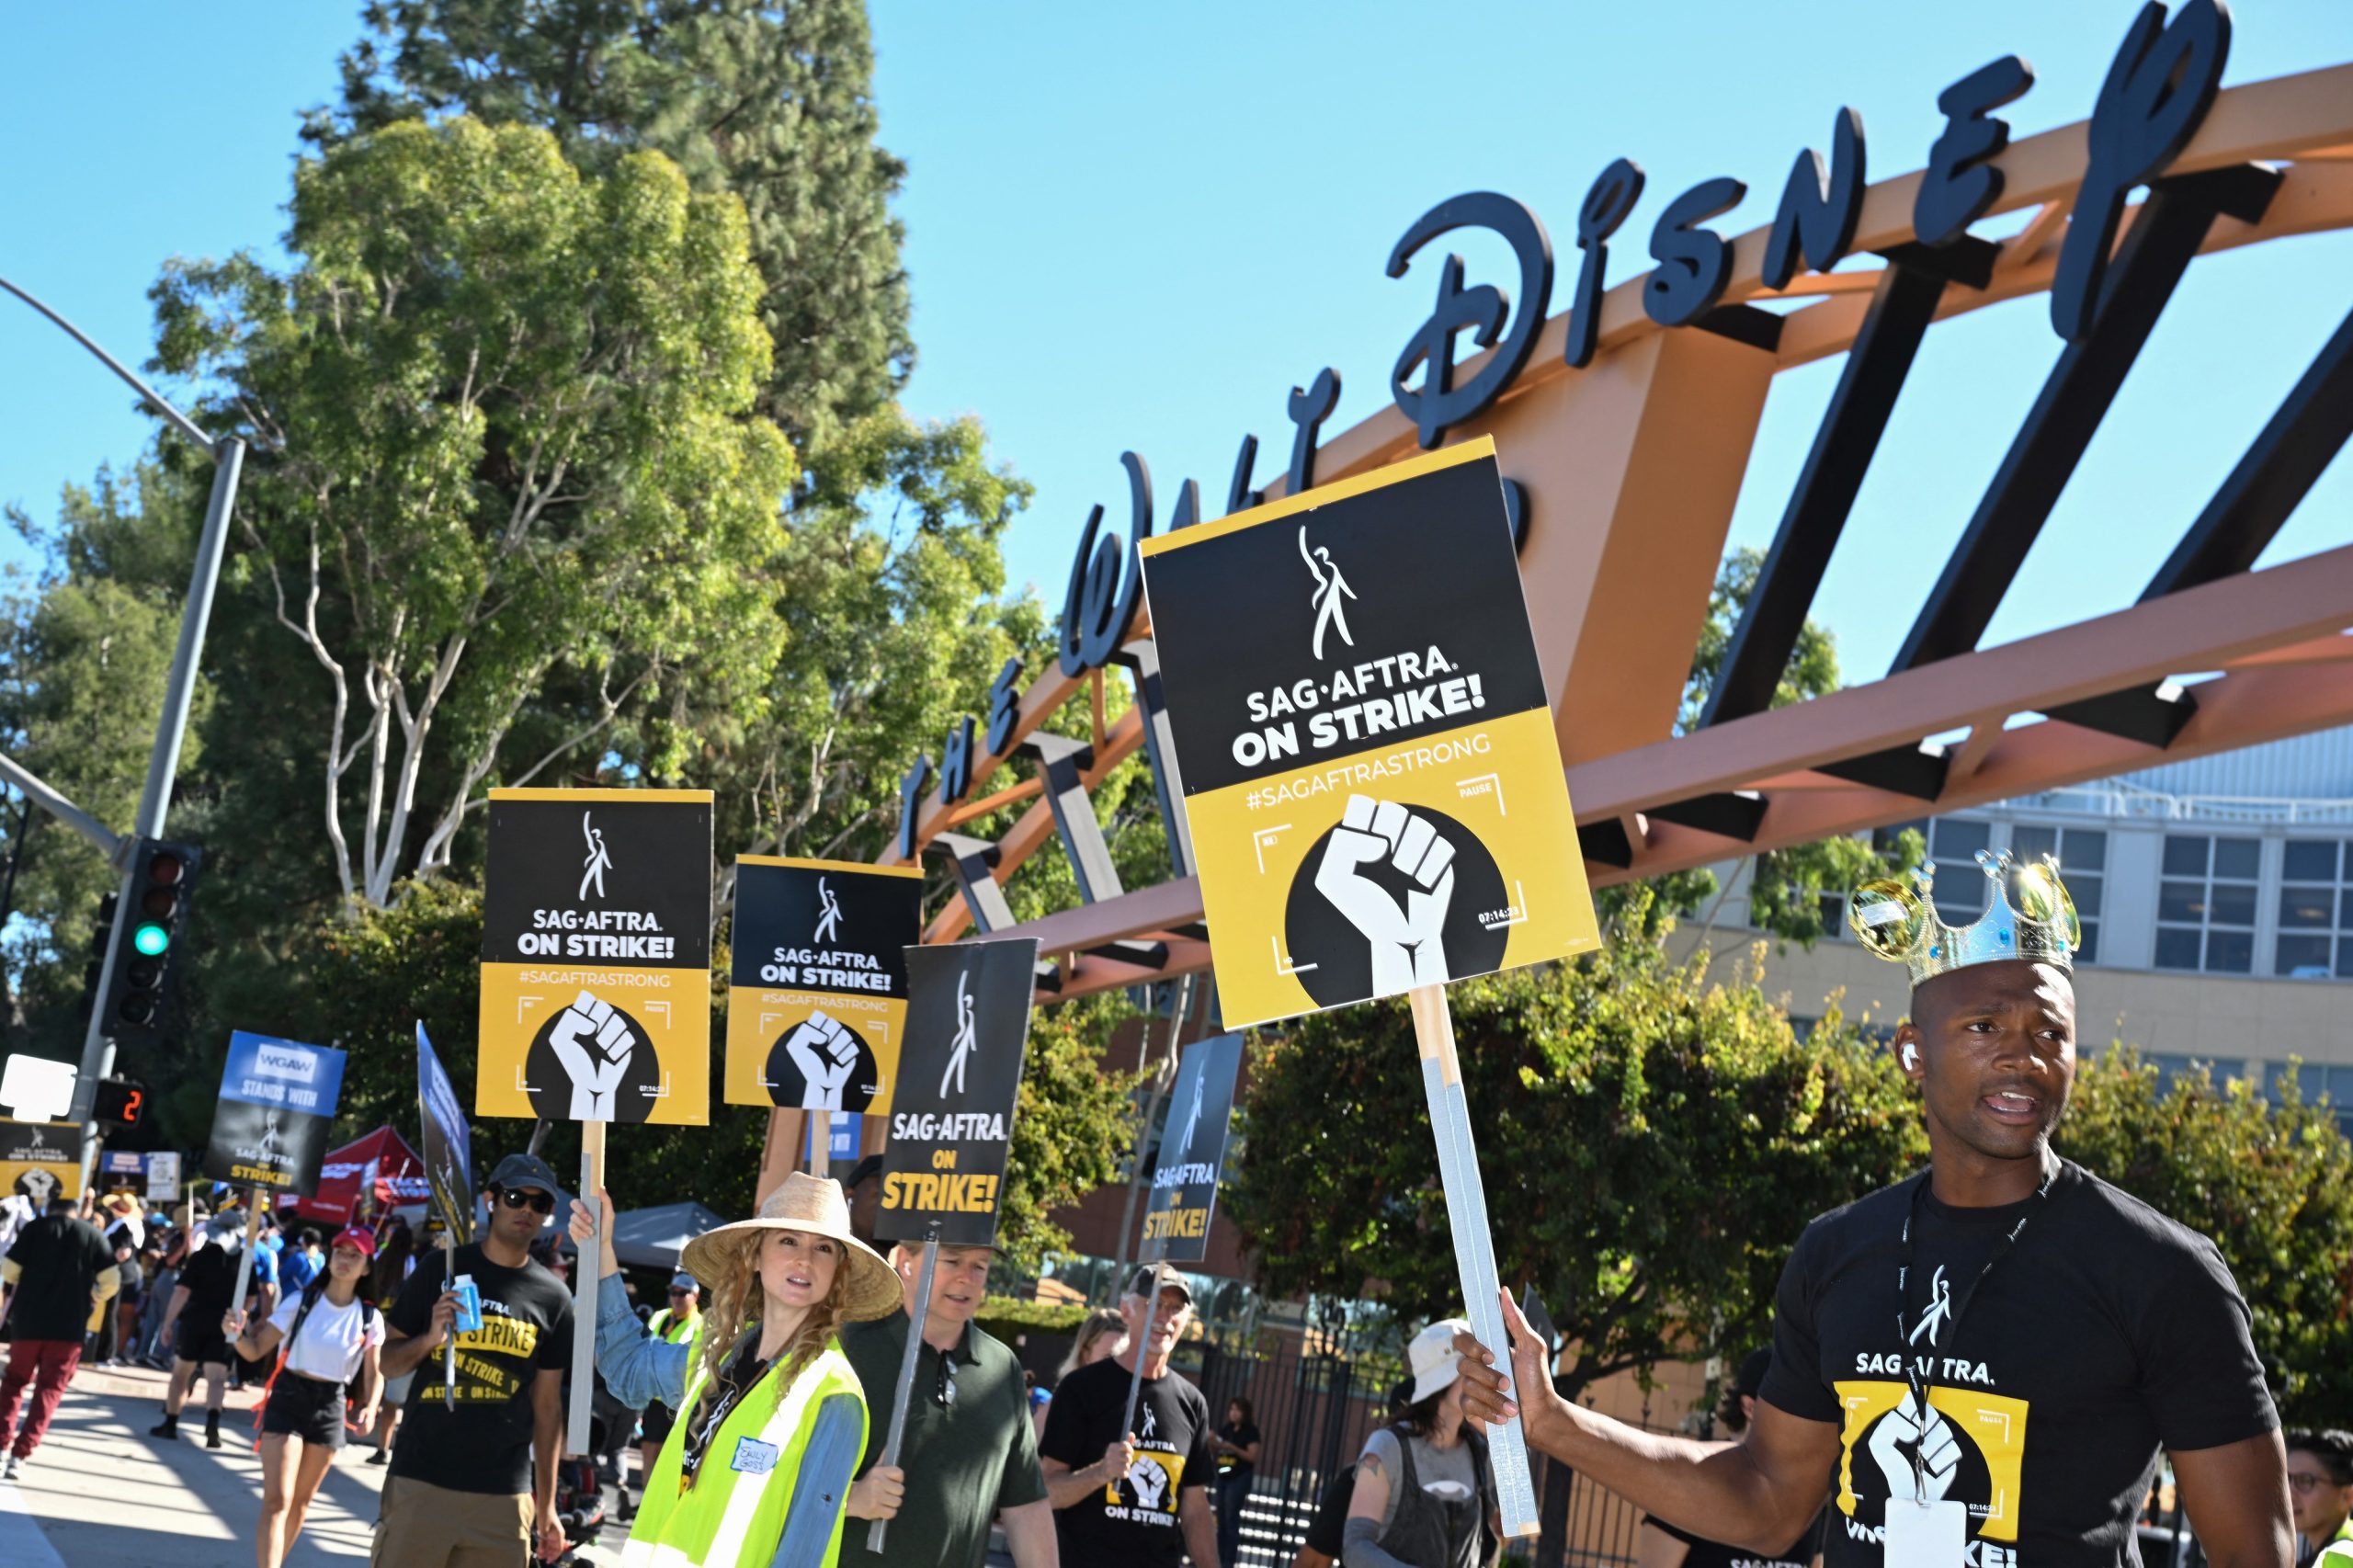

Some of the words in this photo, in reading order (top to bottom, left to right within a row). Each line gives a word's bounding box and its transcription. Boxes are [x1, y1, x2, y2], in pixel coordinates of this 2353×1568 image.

[900, 656, 1025, 860] THE
[1386, 0, 2232, 449] DISNEY
[1232, 722, 1300, 767] ON
[1308, 673, 1486, 748] STRIKE!
[1245, 733, 1492, 811] #SAGAFTRASTRONG
[1459, 782, 1493, 799] PAUSE
[517, 932, 560, 955] ON
[566, 934, 675, 960] STRIKE!
[519, 971, 671, 988] #SAGAFTRASTRONG
[760, 964, 797, 983] ON
[801, 967, 892, 992] STRIKE!
[762, 993, 889, 1013] #SAGAFTRASTRONG
[260, 1053, 313, 1073] WGAW
[123, 1090, 143, 1122] 2
[289, 1087, 318, 1108] WITH
[932, 1149, 958, 1169] ON
[881, 1171, 999, 1213] STRIKE!
[1142, 1208, 1208, 1241] STRIKE!
[465, 1357, 505, 1386] STRIKE
[435, 1386, 463, 1399] STKE
[1105, 1506, 1130, 1520] ON
